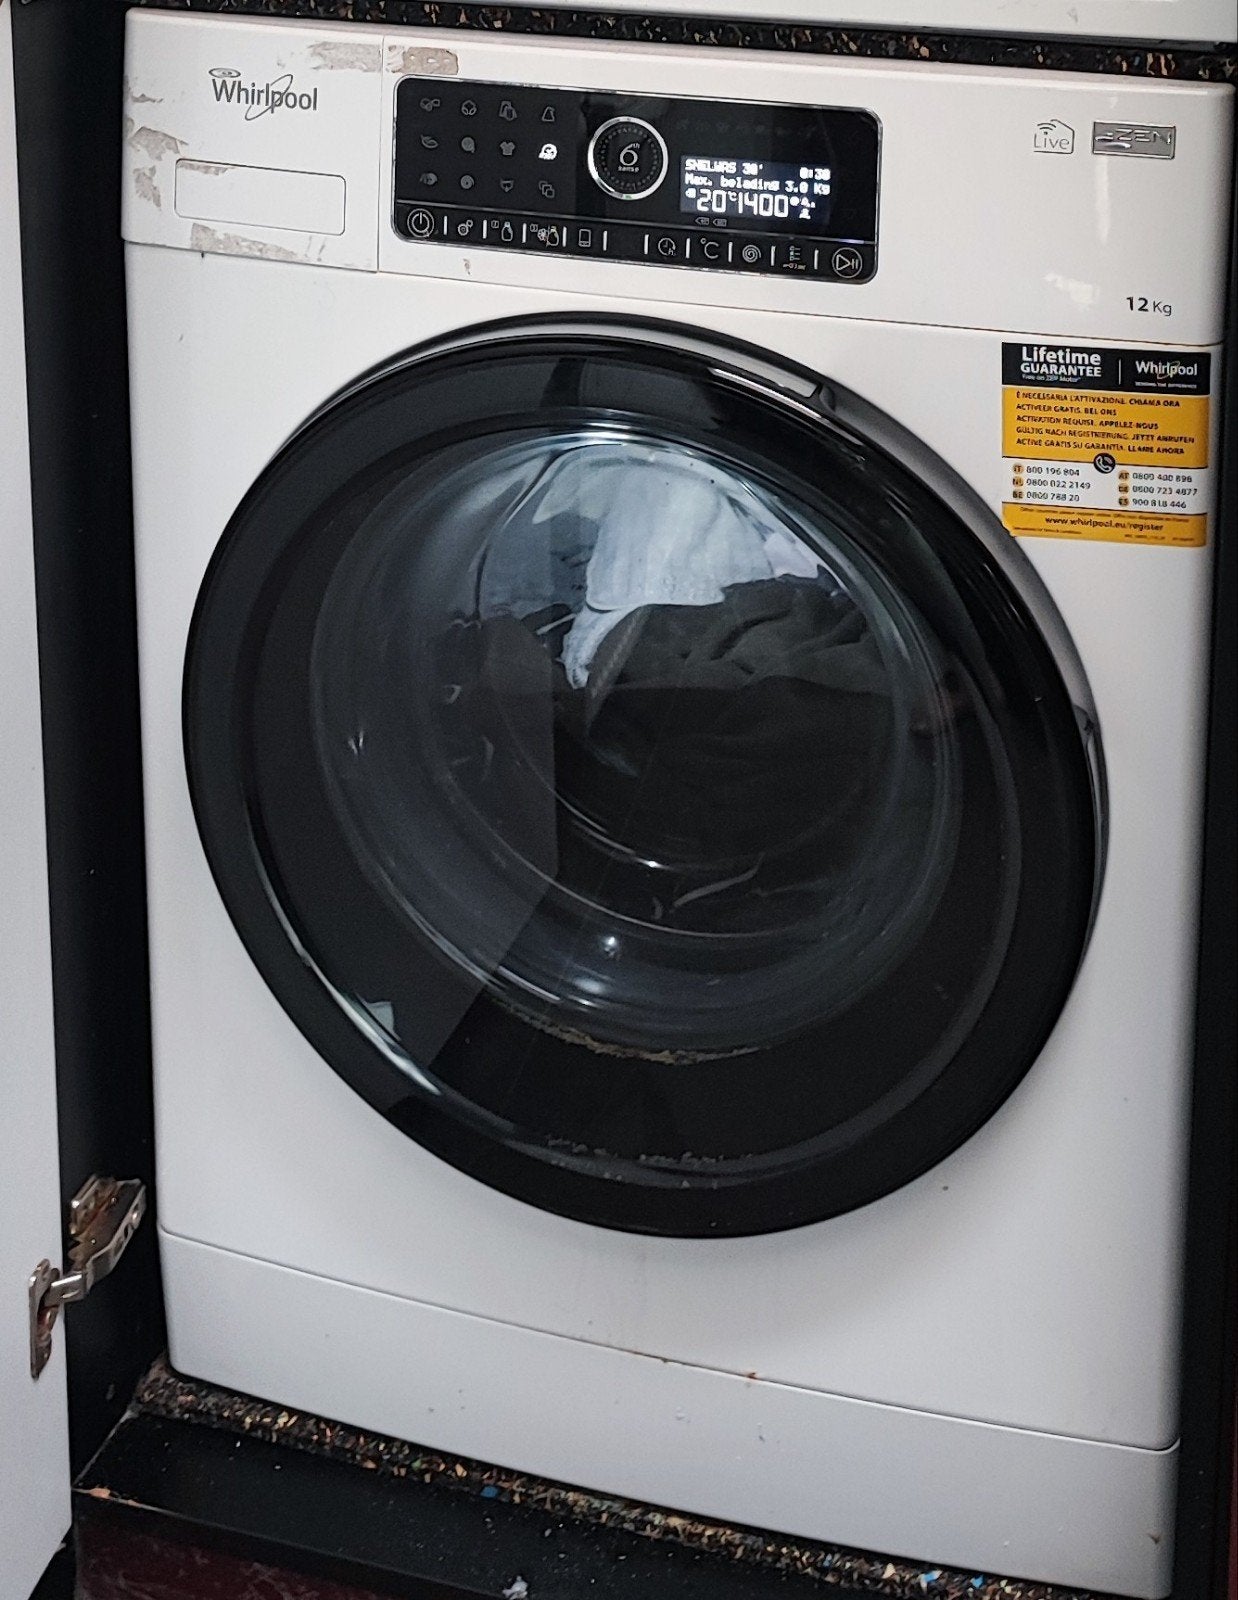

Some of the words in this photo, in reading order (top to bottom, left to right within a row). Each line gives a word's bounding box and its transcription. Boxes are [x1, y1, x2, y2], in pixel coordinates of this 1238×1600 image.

[212, 77, 318, 114] Whirlpool
[1034, 131, 1070, 149] Live
[685, 159, 736, 173] SNELWAS
[800, 167, 830, 180] 0:30
[685, 172, 712, 186] Max.
[720, 175, 780, 191] belading
[785, 180, 808, 193] 3.0
[738, 192, 788, 217] 1400
[1126, 297, 1148, 312] 12
[1152, 301, 1172, 316] Kg
[1022, 346, 1101, 365] Lifetime
[1020, 362, 1102, 377] GUARANTEE
[1135, 360, 1197, 378] Whirlpool
[1016, 404, 1052, 412] ACTIVEER
[1129, 398, 1161, 406] CHIAMA
[1017, 415, 1061, 424] ACTIVATION
[1045, 428, 1066, 436] NACH
[1016, 438, 1042, 446] ACTIVE
[1045, 440, 1071, 448] GRATIS
[1027, 466, 1043, 474] 800
[1046, 467, 1061, 475] 196
[1063, 468, 1080, 476] 804
[1132, 472, 1154, 480] 0800
[1050, 480, 1066, 488] 022
[1068, 481, 1090, 489] 2149
[1027, 491, 1048, 499] 0800
